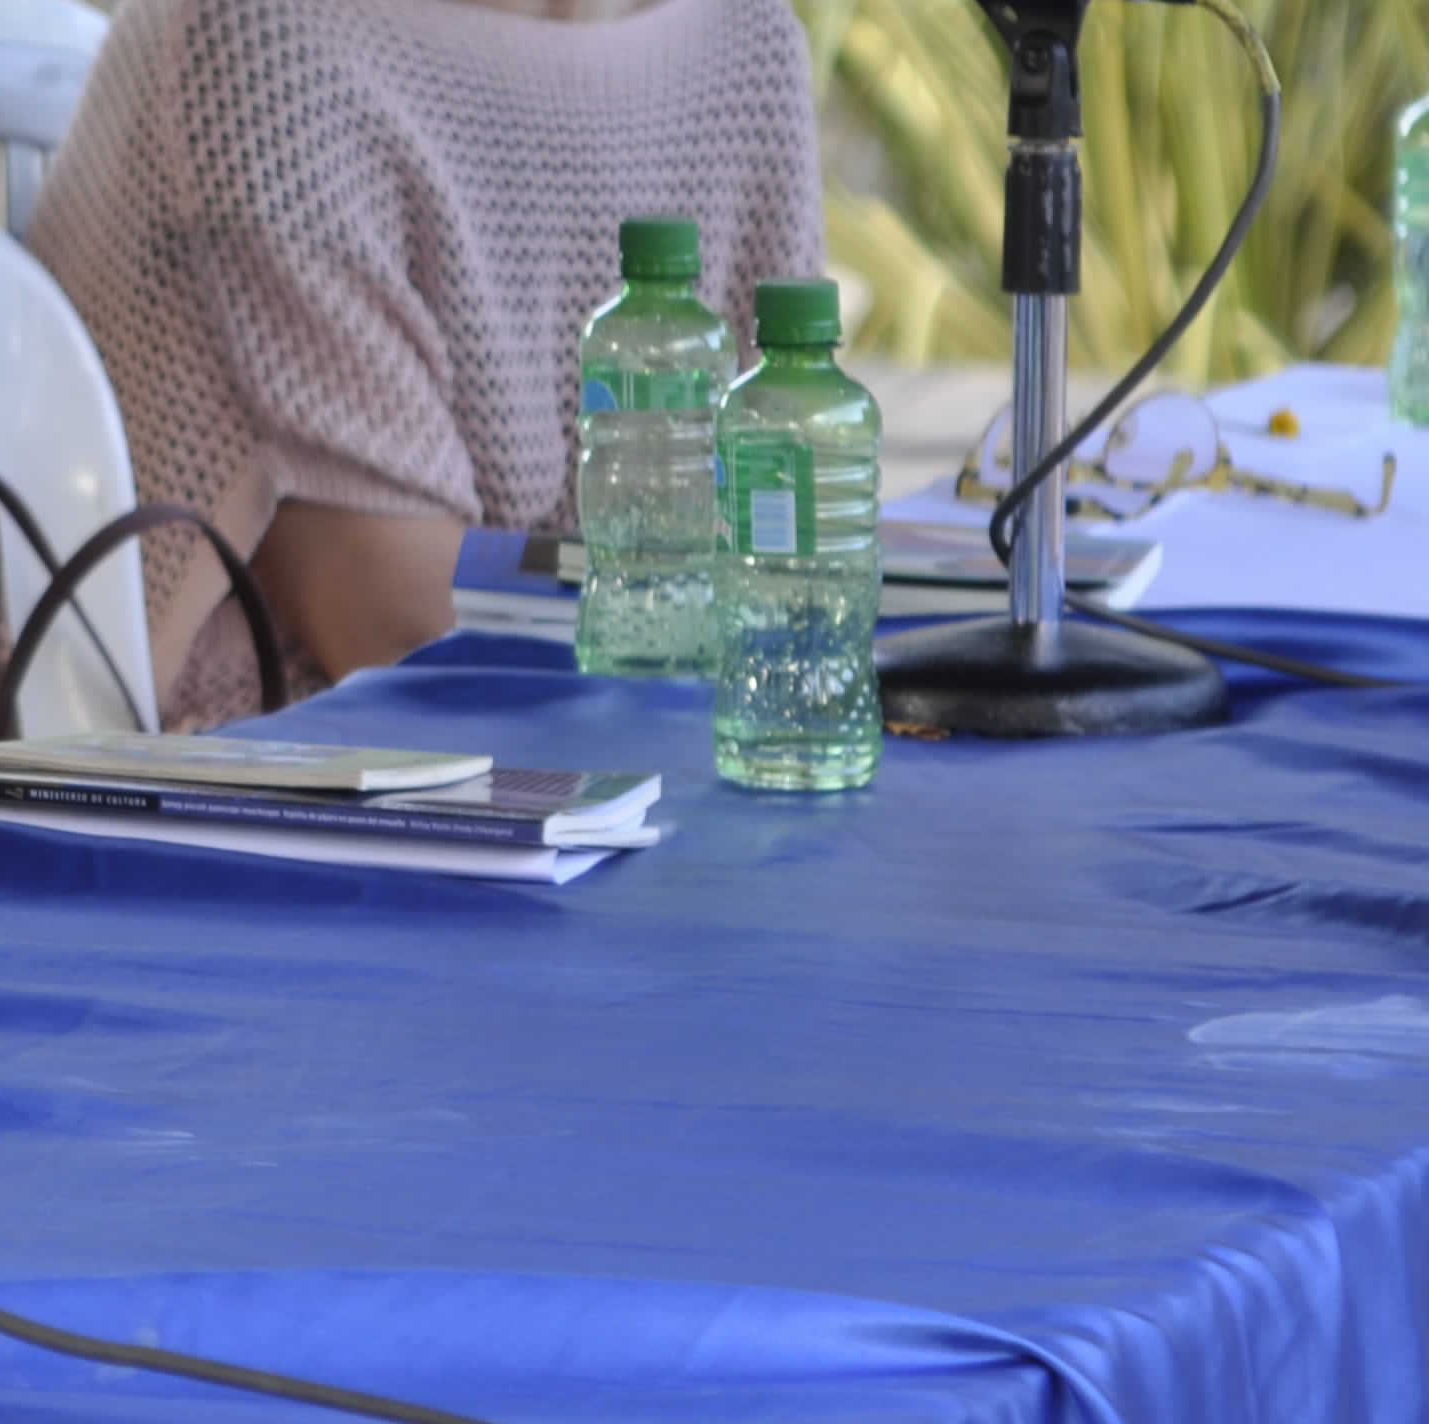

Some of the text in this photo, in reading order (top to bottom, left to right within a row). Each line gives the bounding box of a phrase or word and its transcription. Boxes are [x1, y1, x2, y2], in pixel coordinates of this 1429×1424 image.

[29, 788, 147, 807] MINISTERIO DE CULTURA
